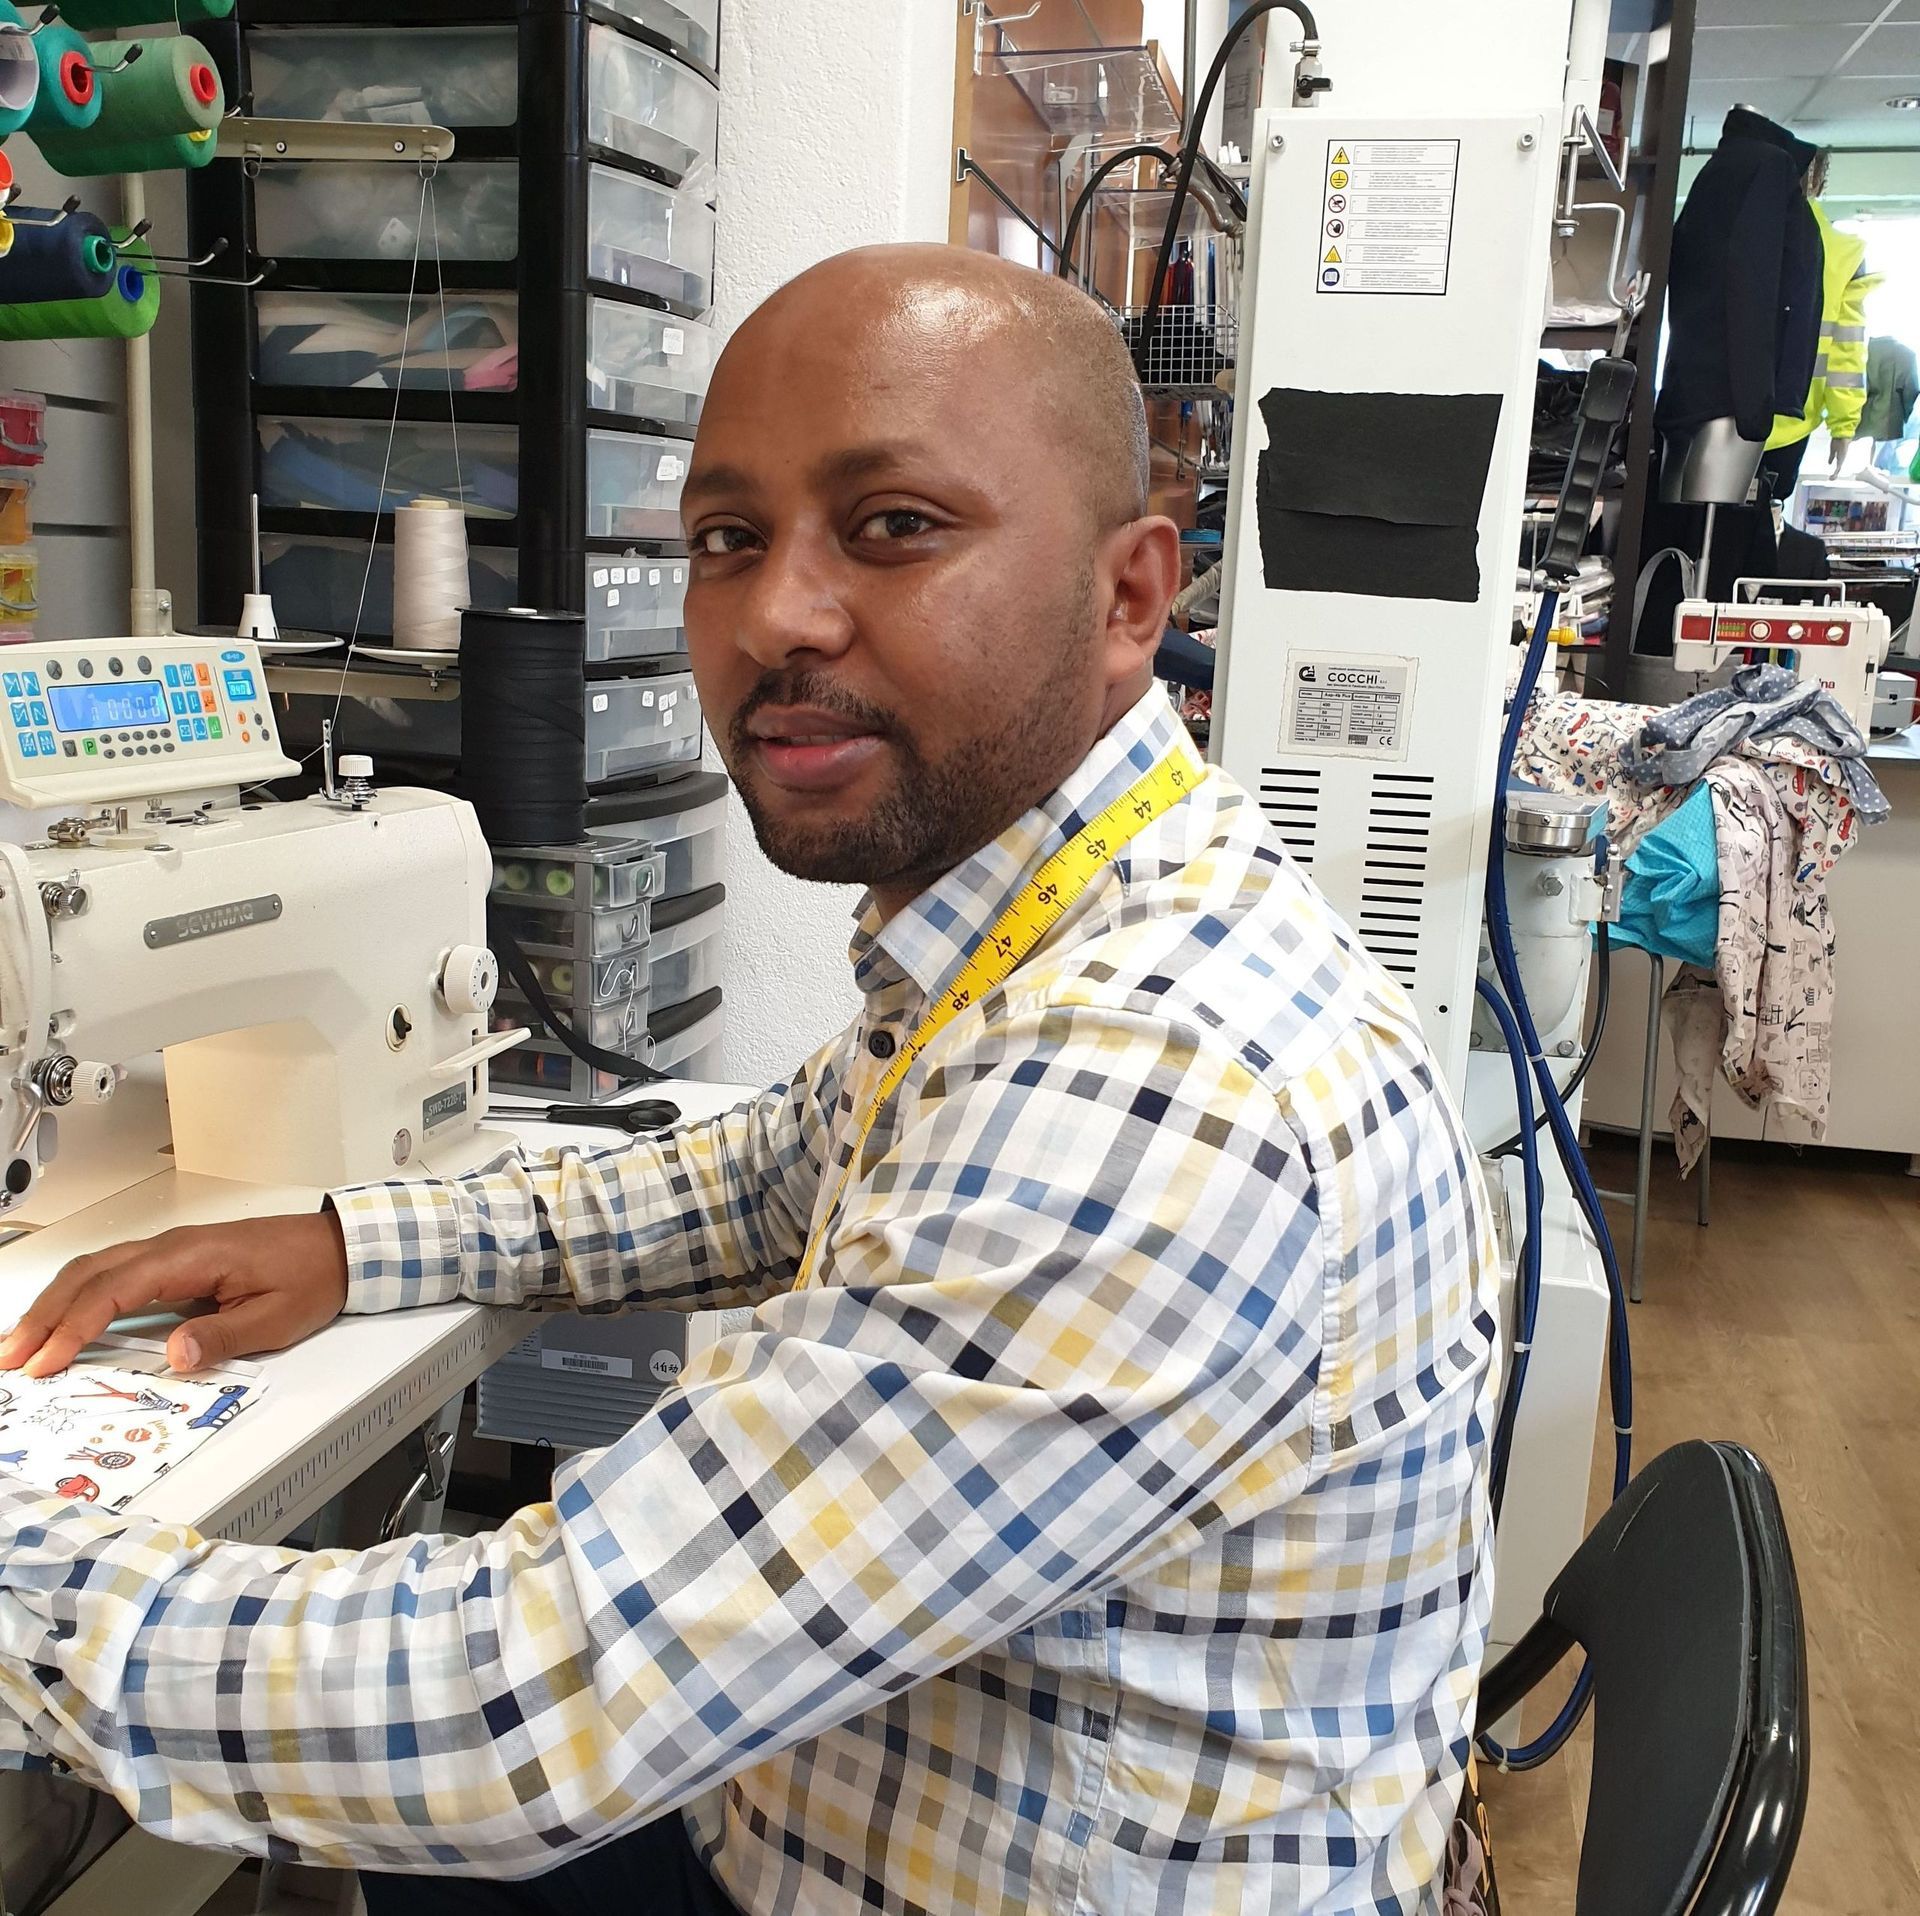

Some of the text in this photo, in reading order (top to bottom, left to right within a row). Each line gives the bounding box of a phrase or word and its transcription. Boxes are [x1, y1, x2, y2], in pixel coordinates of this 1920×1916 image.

[1327, 672, 1378, 685] COCCHI
[86, 741, 94, 753] P
[1171, 770, 1184, 786] 43
[1133, 800, 1152, 819] 44
[1086, 839, 1107, 859] 45
[1037, 883, 1057, 905] 46
[176, 902, 254, 938] SEWMAQ
[995, 935, 1012, 958] 47
[952, 989, 970, 1012] 48
[274, 1506, 284, 1520] 20
